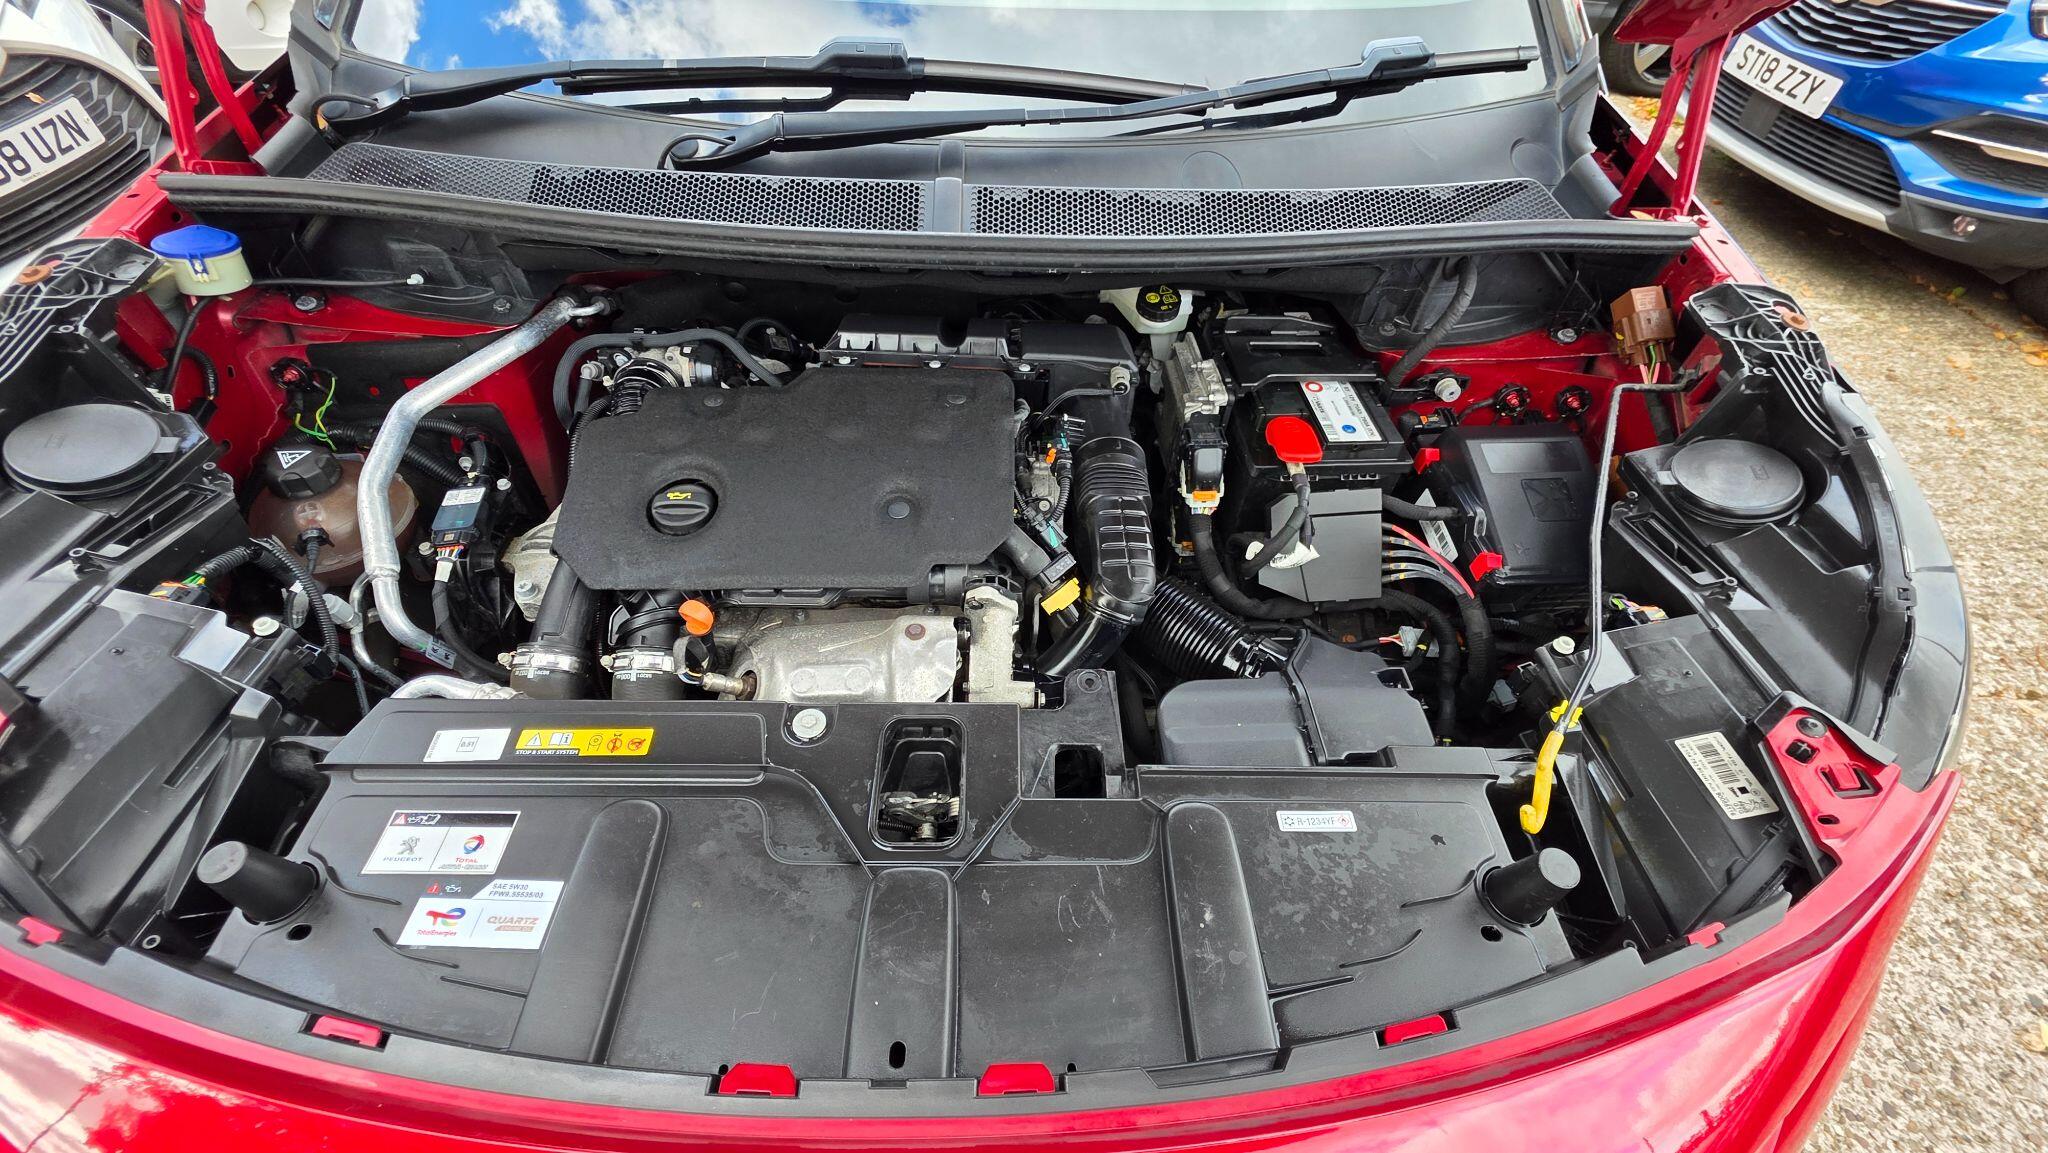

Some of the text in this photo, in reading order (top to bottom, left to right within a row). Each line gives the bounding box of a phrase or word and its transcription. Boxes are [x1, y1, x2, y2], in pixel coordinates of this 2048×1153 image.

[1736, 44, 1826, 104] ST18 ZZY
[20, 109, 90, 163] UZN
[416, 929, 457, 937] TotalEnergies
[487, 916, 539, 925] QUARTZ
